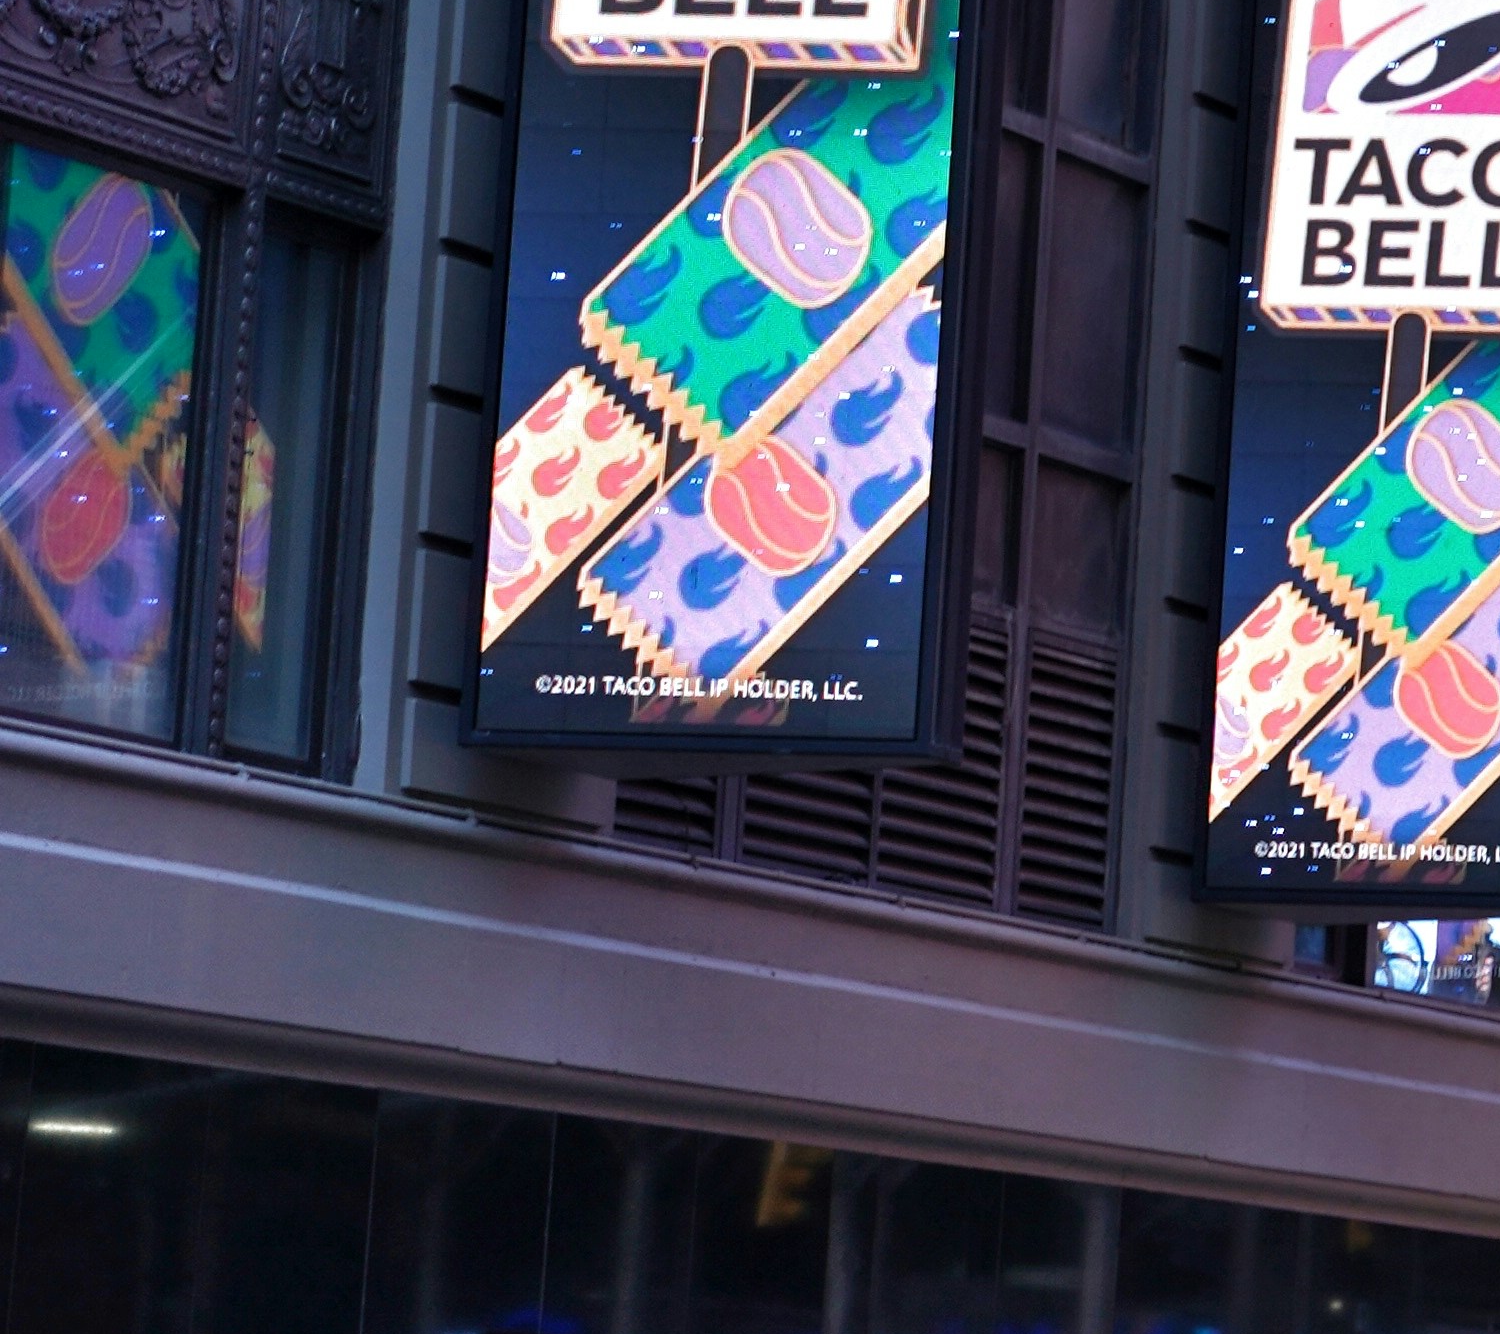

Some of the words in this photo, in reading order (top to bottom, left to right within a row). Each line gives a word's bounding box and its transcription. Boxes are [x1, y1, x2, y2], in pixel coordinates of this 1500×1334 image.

[535, 674, 596, 695] ©2021
[602, 675, 656, 697] TACO
[659, 676, 705, 698] BELL
[709, 678, 728, 698] IP
[733, 678, 818, 703] HOLDER,
[823, 680, 864, 702] LLC.
[1255, 840, 1305, 859] ©2021
[1310, 841, 1355, 860] TACO
[1358, 842, 1398, 862] BELL
[1400, 844, 1416, 862] IP
[1420, 844, 1491, 865] HOLDER,
